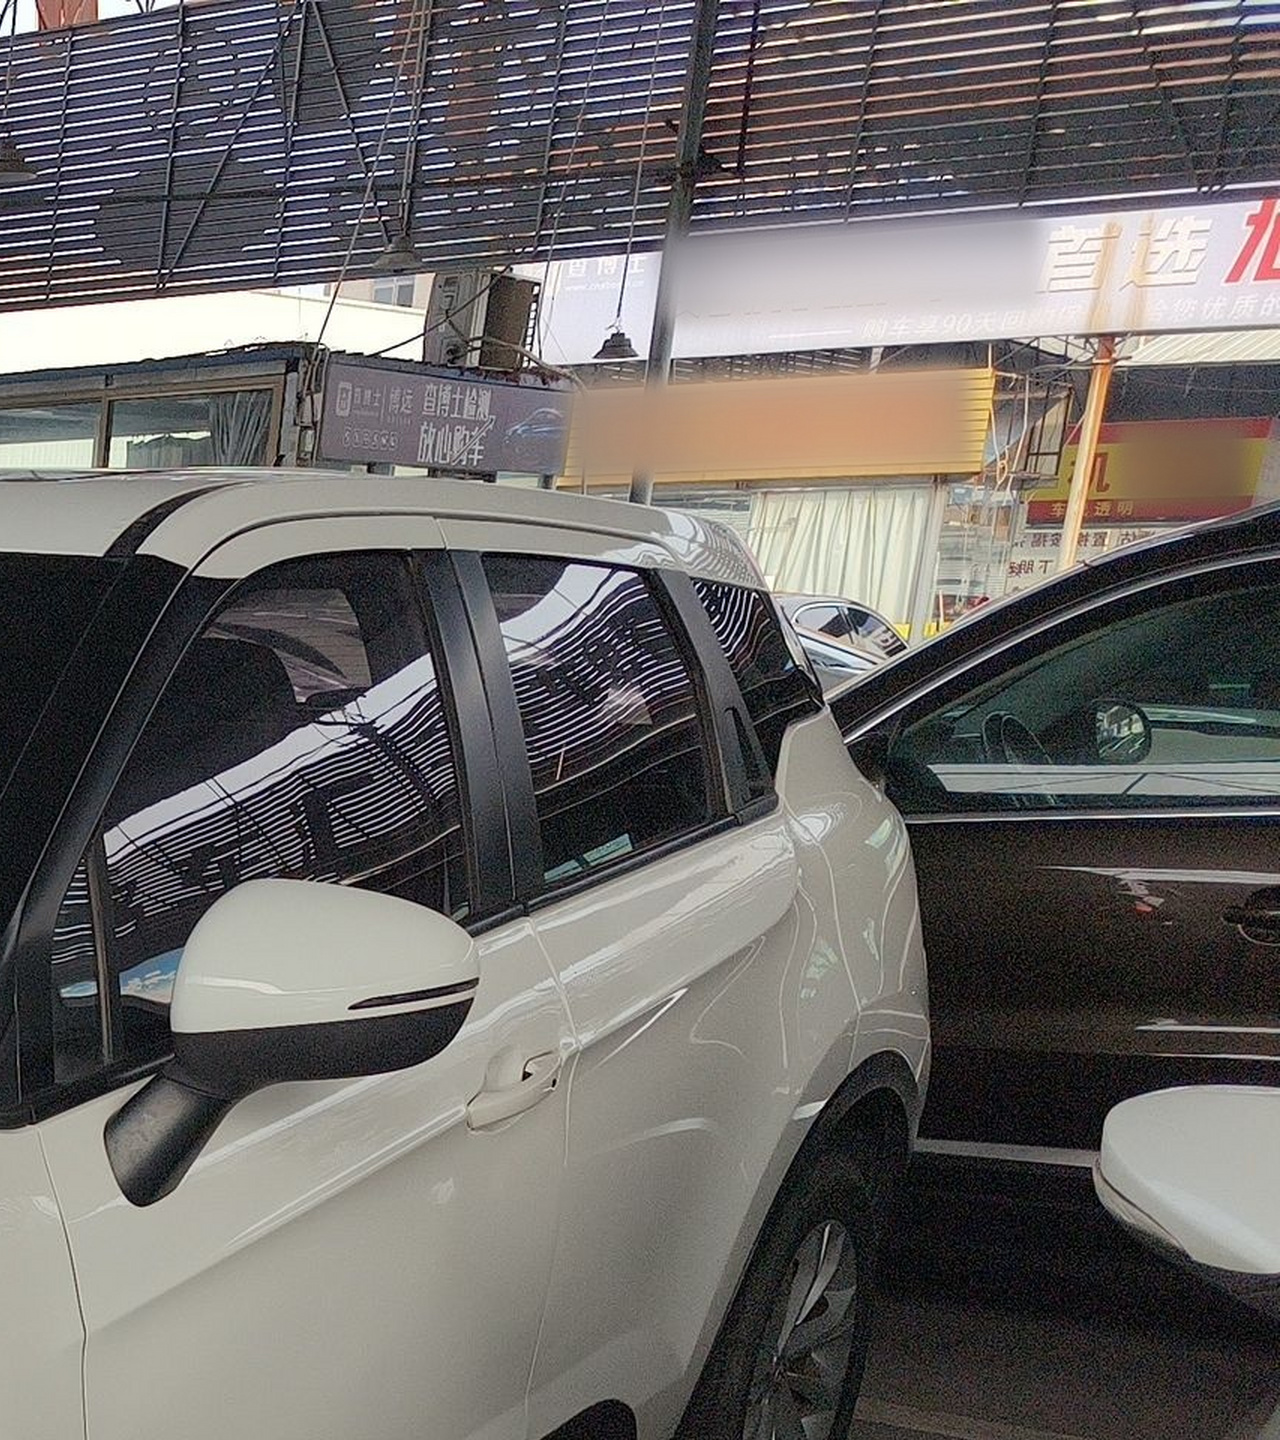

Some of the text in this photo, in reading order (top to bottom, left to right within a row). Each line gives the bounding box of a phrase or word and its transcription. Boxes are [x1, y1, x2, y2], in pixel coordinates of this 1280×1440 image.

[422, 383, 492, 421] 查博士检测
[417, 421, 486, 466] 放心购车
[1051, 500, 1134, 518] 车透明
